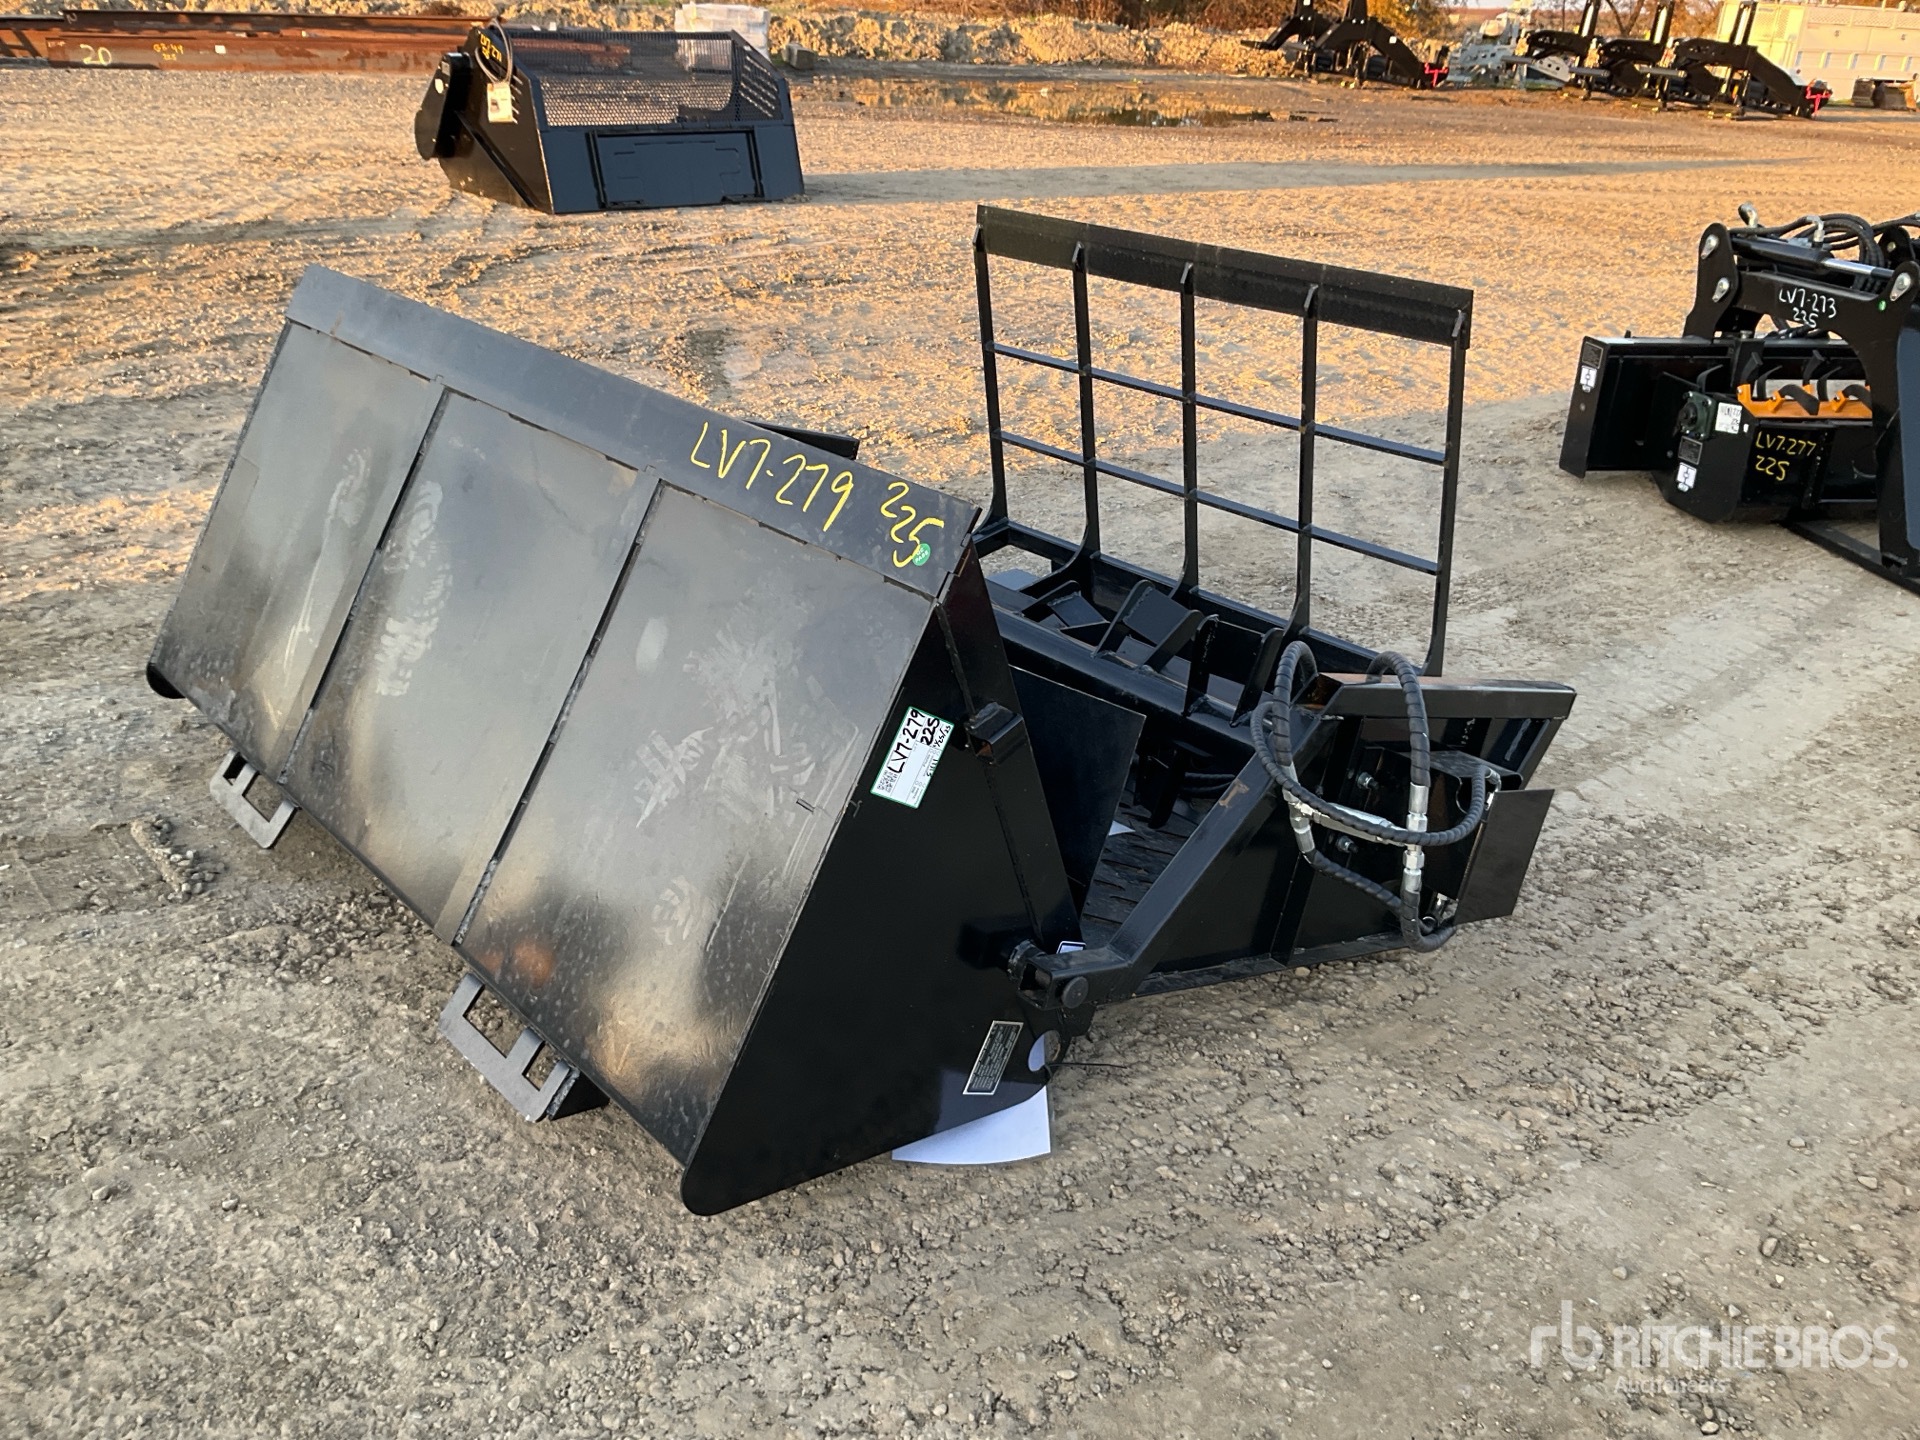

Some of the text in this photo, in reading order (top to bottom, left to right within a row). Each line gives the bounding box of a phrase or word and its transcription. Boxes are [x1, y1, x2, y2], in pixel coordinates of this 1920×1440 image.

[79, 43, 112, 66] 20
[1778, 287, 1837, 319] LV7-273
[1792, 306, 1819, 328] 225
[689, 421, 855, 532] LV7-279
[1755, 455, 1790, 482] 225
[880, 481, 945, 568] 225
[887, 708, 926, 774] LV7-279
[919, 717, 940, 746] 225
